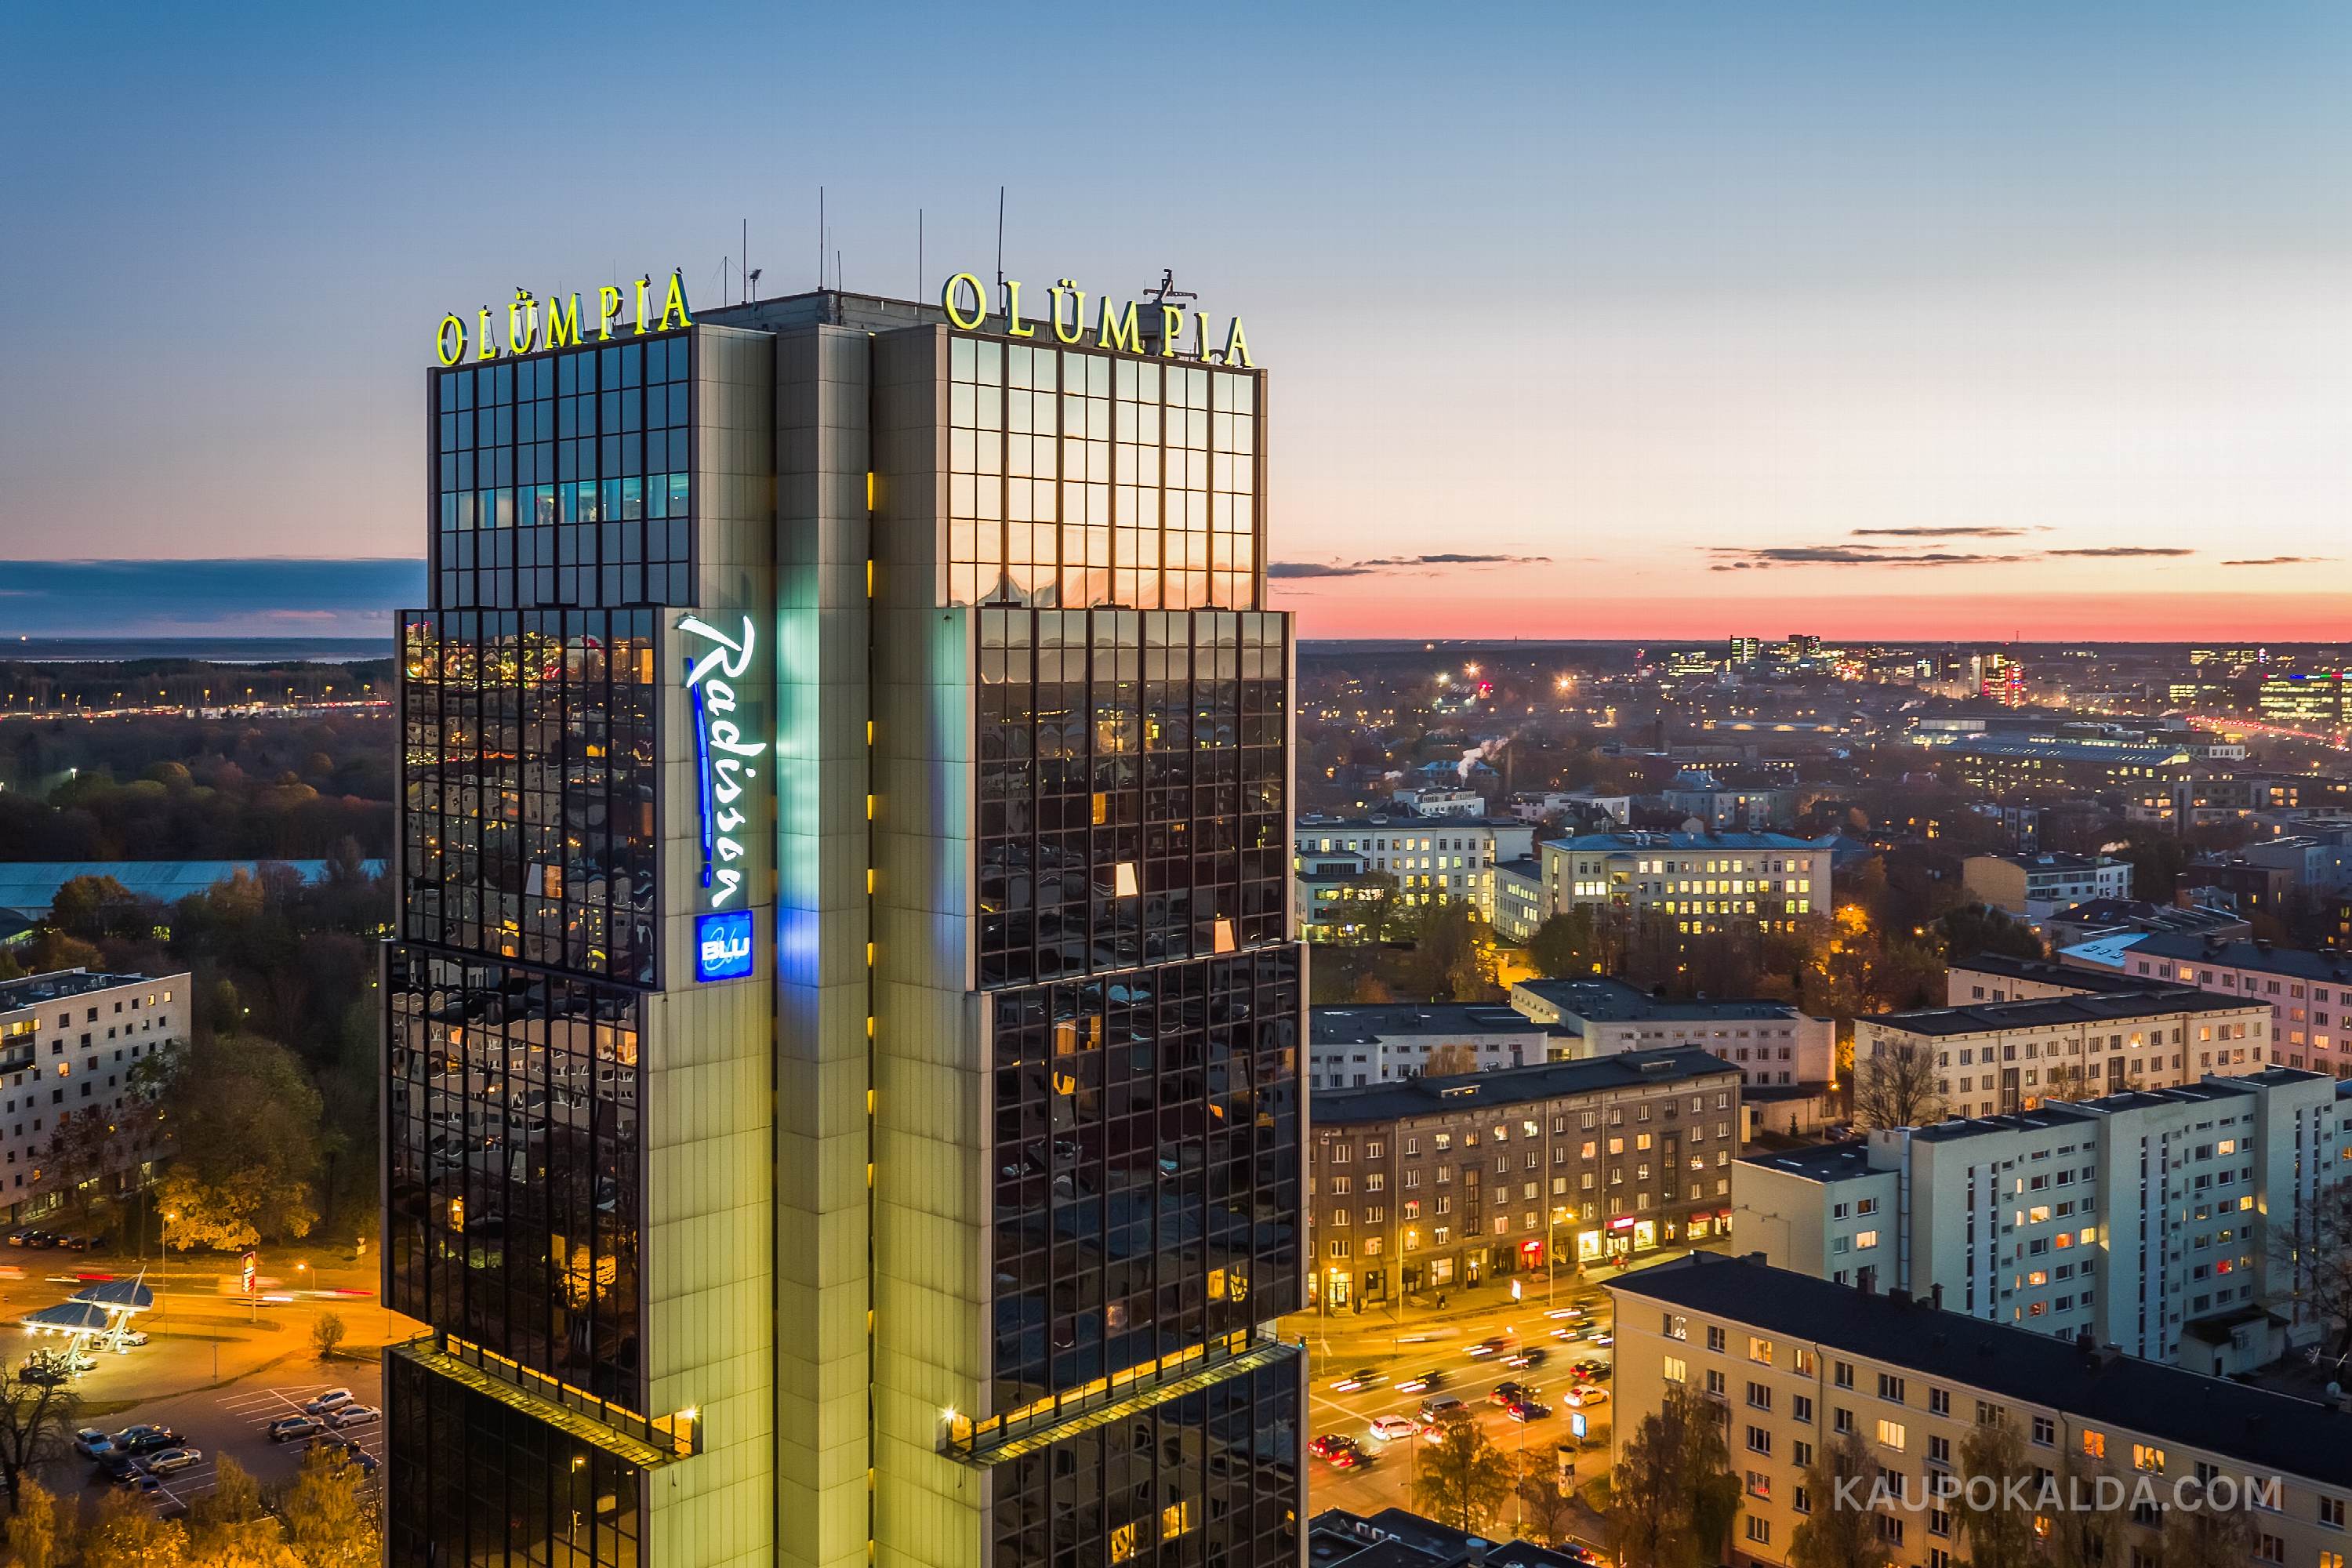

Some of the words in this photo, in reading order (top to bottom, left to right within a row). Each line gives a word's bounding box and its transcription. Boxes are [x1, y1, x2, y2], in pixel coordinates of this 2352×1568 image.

[437, 272, 694, 366] OLÜMPIA
[942, 273, 1254, 368] OLÜMPIA
[677, 615, 767, 908] Radisson
[702, 937, 750, 961] BLU
